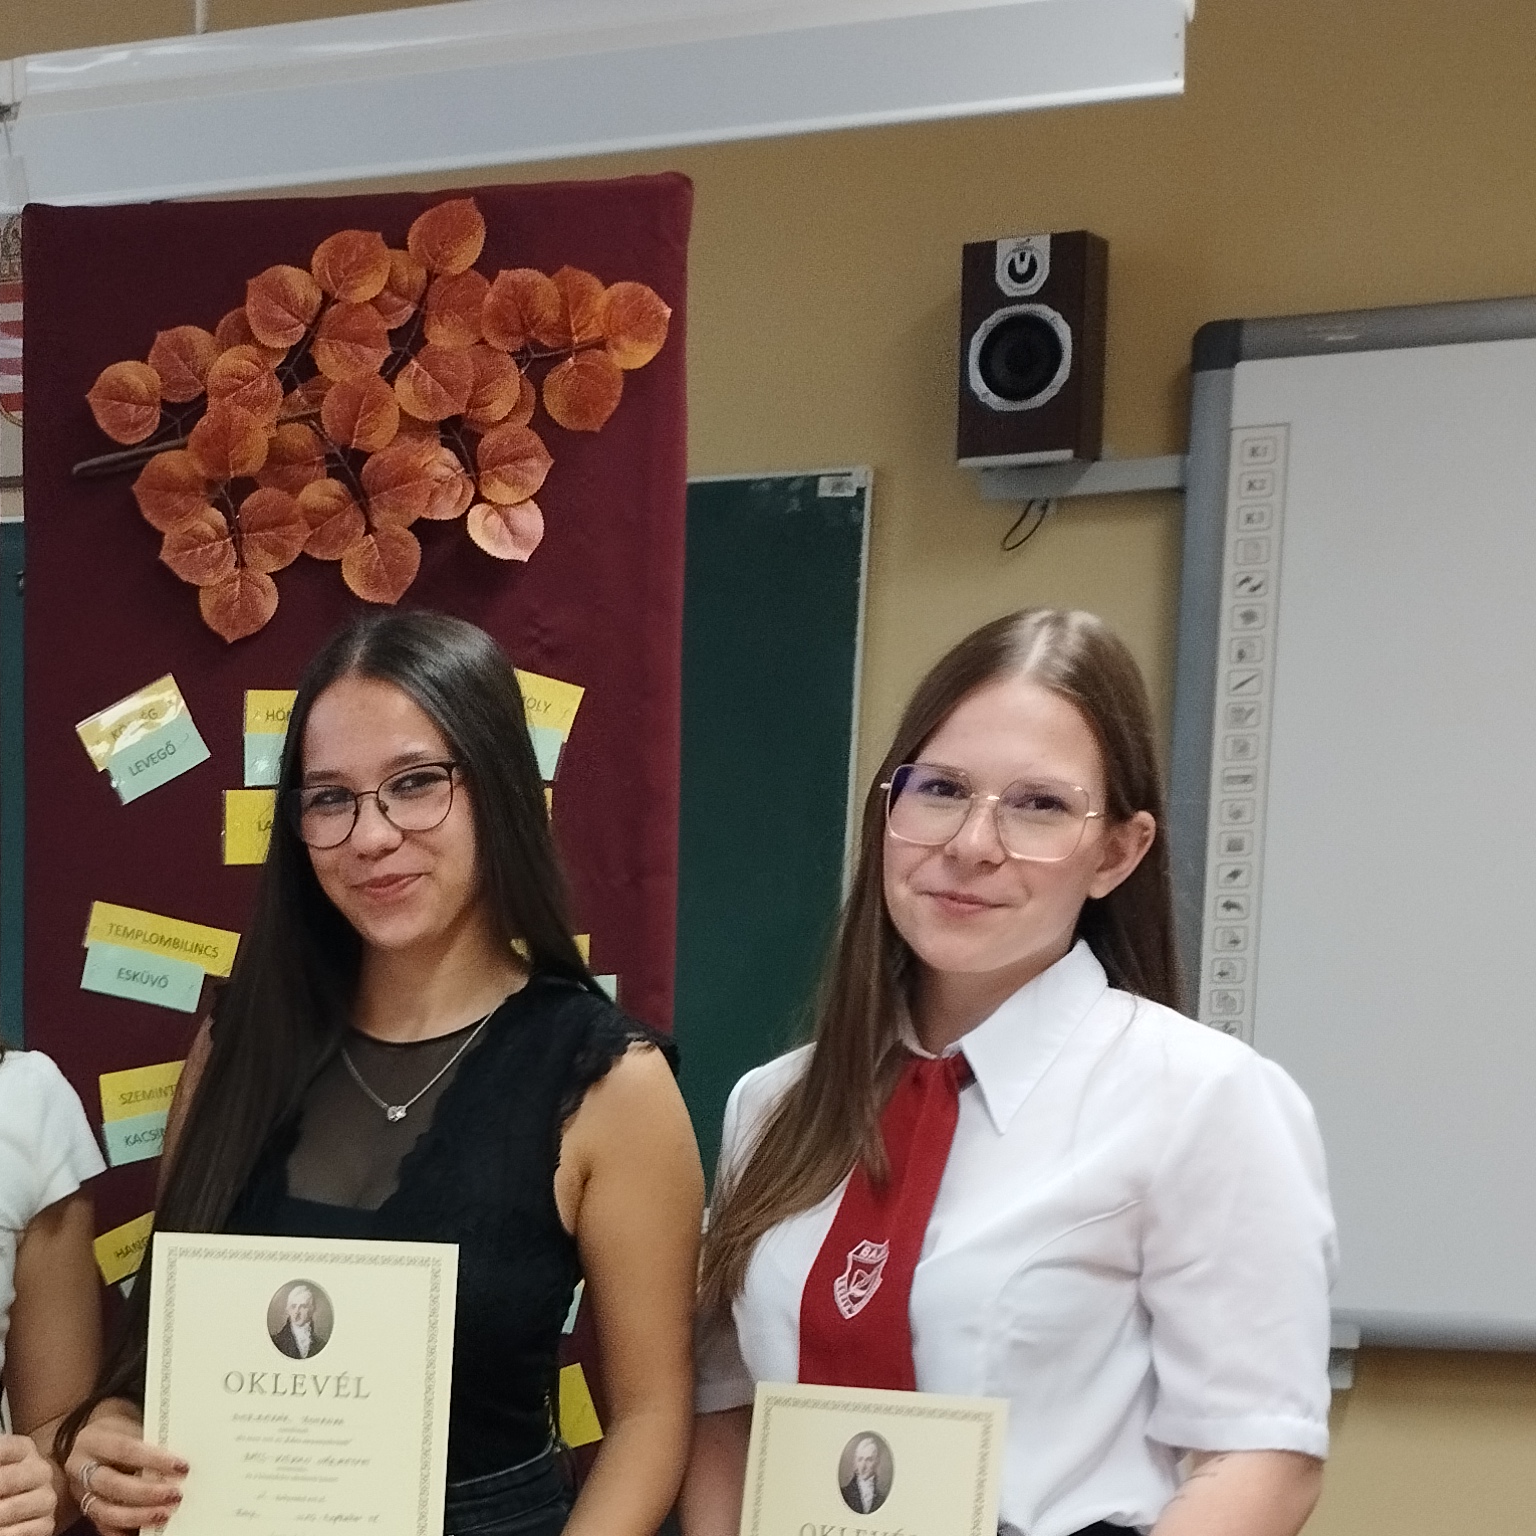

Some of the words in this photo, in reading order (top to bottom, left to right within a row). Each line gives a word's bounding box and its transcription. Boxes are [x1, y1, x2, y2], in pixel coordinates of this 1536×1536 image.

[128, 740, 177, 777] LEVEGŐ
[107, 922, 220, 959] TEMPLOMBILINCS
[119, 1084, 177, 1106] SZEMINT
[114, 1235, 150, 1260] HANG
[223, 1371, 371, 1399] OKLEVÉL
